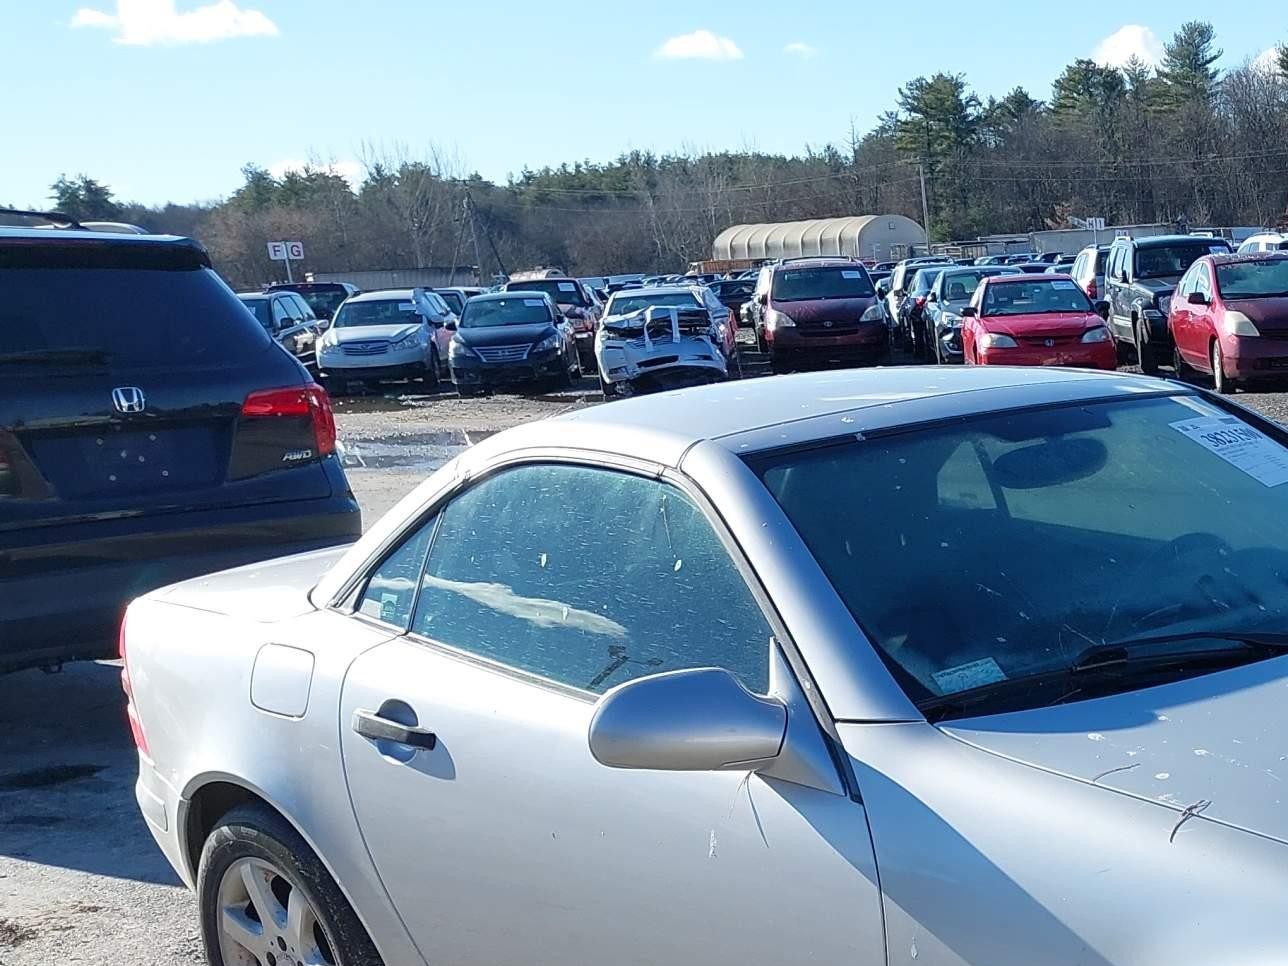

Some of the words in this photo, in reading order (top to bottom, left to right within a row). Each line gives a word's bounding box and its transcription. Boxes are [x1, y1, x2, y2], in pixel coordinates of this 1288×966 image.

[272, 245, 281, 257] F
[290, 244, 302, 257] G
[282, 449, 312, 461] AWD
